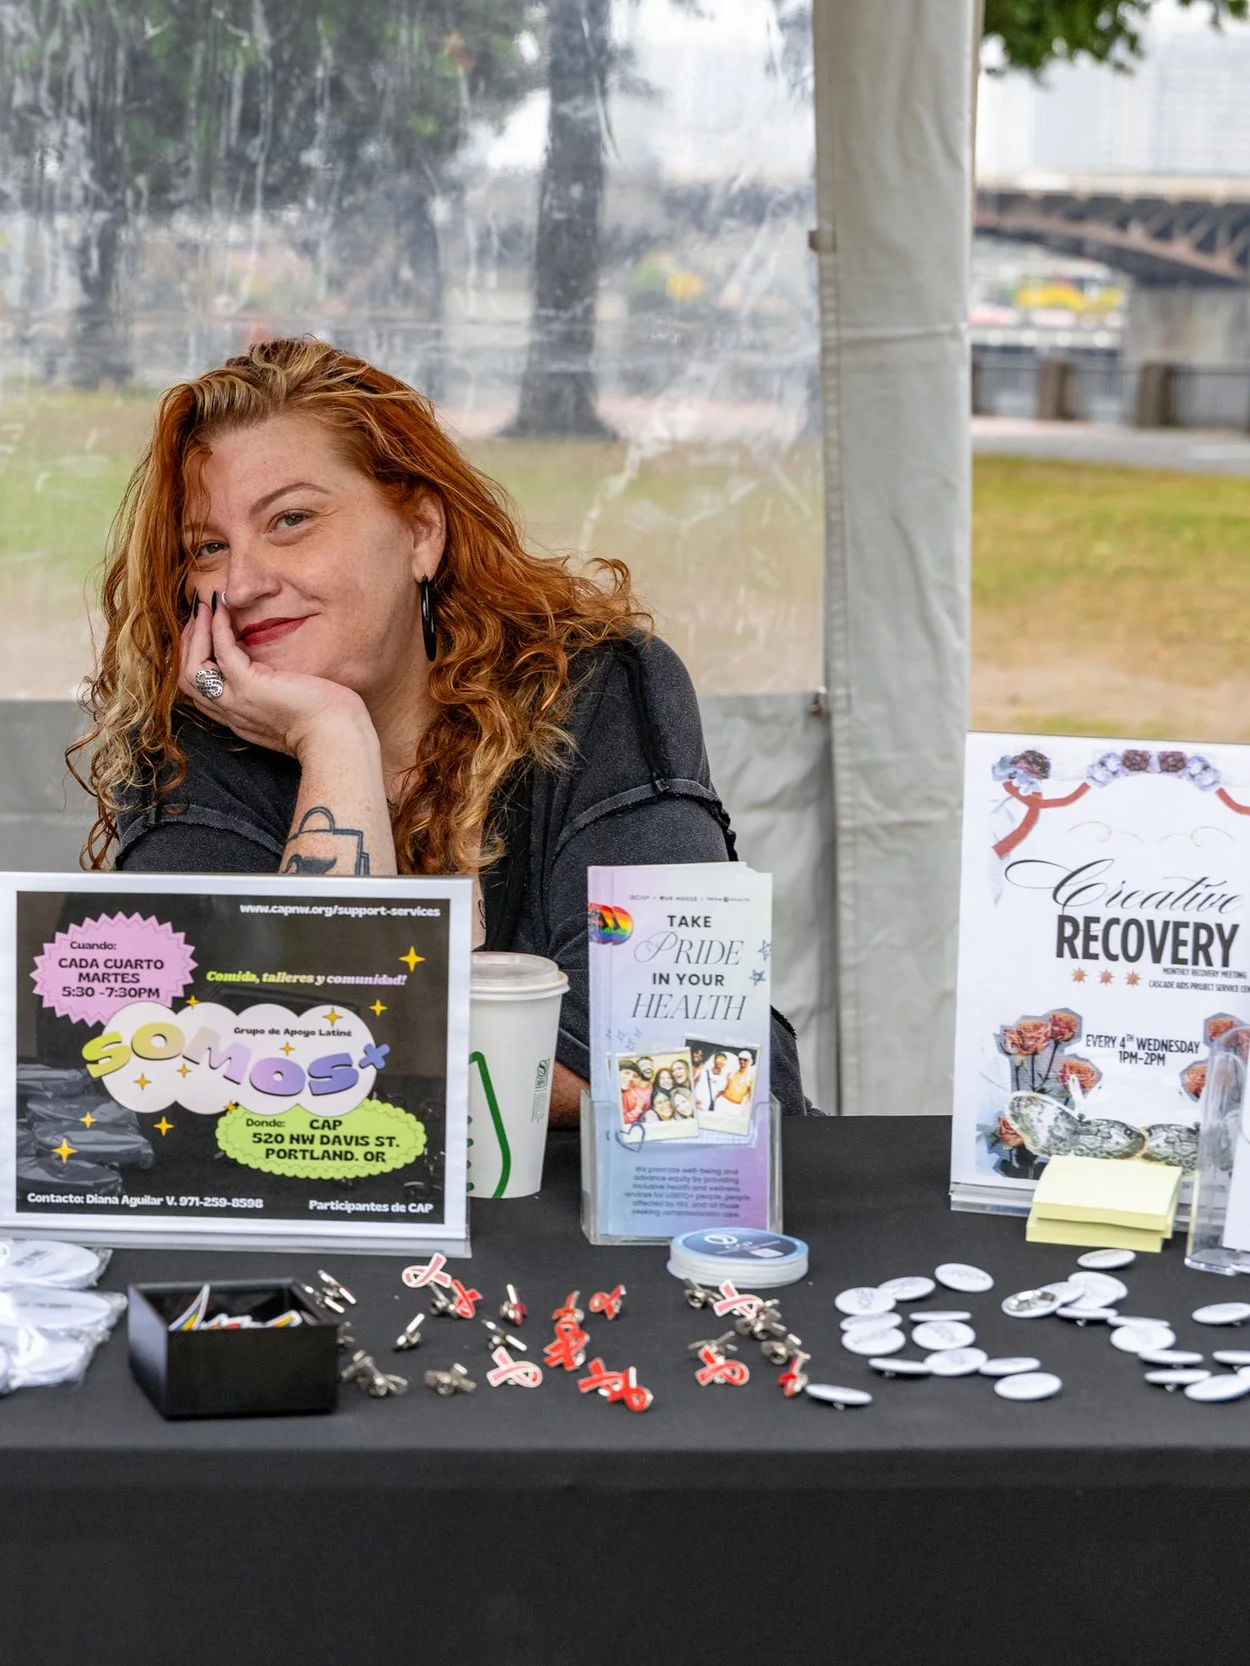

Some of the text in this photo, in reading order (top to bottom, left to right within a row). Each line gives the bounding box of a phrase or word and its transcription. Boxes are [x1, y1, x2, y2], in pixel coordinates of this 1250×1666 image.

[1004, 858, 1244, 916] Creative
[240, 904, 441, 918] www.capnw.org/support-services
[666, 915, 712, 928] TAKE
[70, 941, 117, 950] Cuando:
[1056, 914, 1240, 968] RECOVERY
[633, 931, 744, 965] PRIDE
[58, 958, 164, 970] CADA CUARTO
[78, 972, 140, 984] MARTES
[206, 970, 407, 986] Comida, talleres y comunidad!
[1162, 967, 1189, 976] MONTHLY
[1191, 969, 1219, 977] RECOVERY
[652, 973, 725, 987] IN YOUR
[1149, 980, 1174, 989] CASCADE
[62, 986, 95, 997] 5:30
[631, 993, 747, 1021] HEALTH
[234, 1026, 265, 1036] Grupo
[268, 1027, 280, 1035] de
[283, 1027, 316, 1037] Apoyo
[1086, 1034, 1117, 1048] EVERY
[1136, 1037, 1200, 1054] WEDNESDAY
[246, 1118, 286, 1128] Donde:
[309, 1119, 343, 1131] CAP
[252, 1132, 400, 1148] 520 NW DAVIS ST.
[363, 1151, 387, 1163] OR
[27, 1192, 264, 1209] Contacto: Diana Aguilar V. 971-259-8598
[309, 1199, 434, 1214] Participantes de CAP
